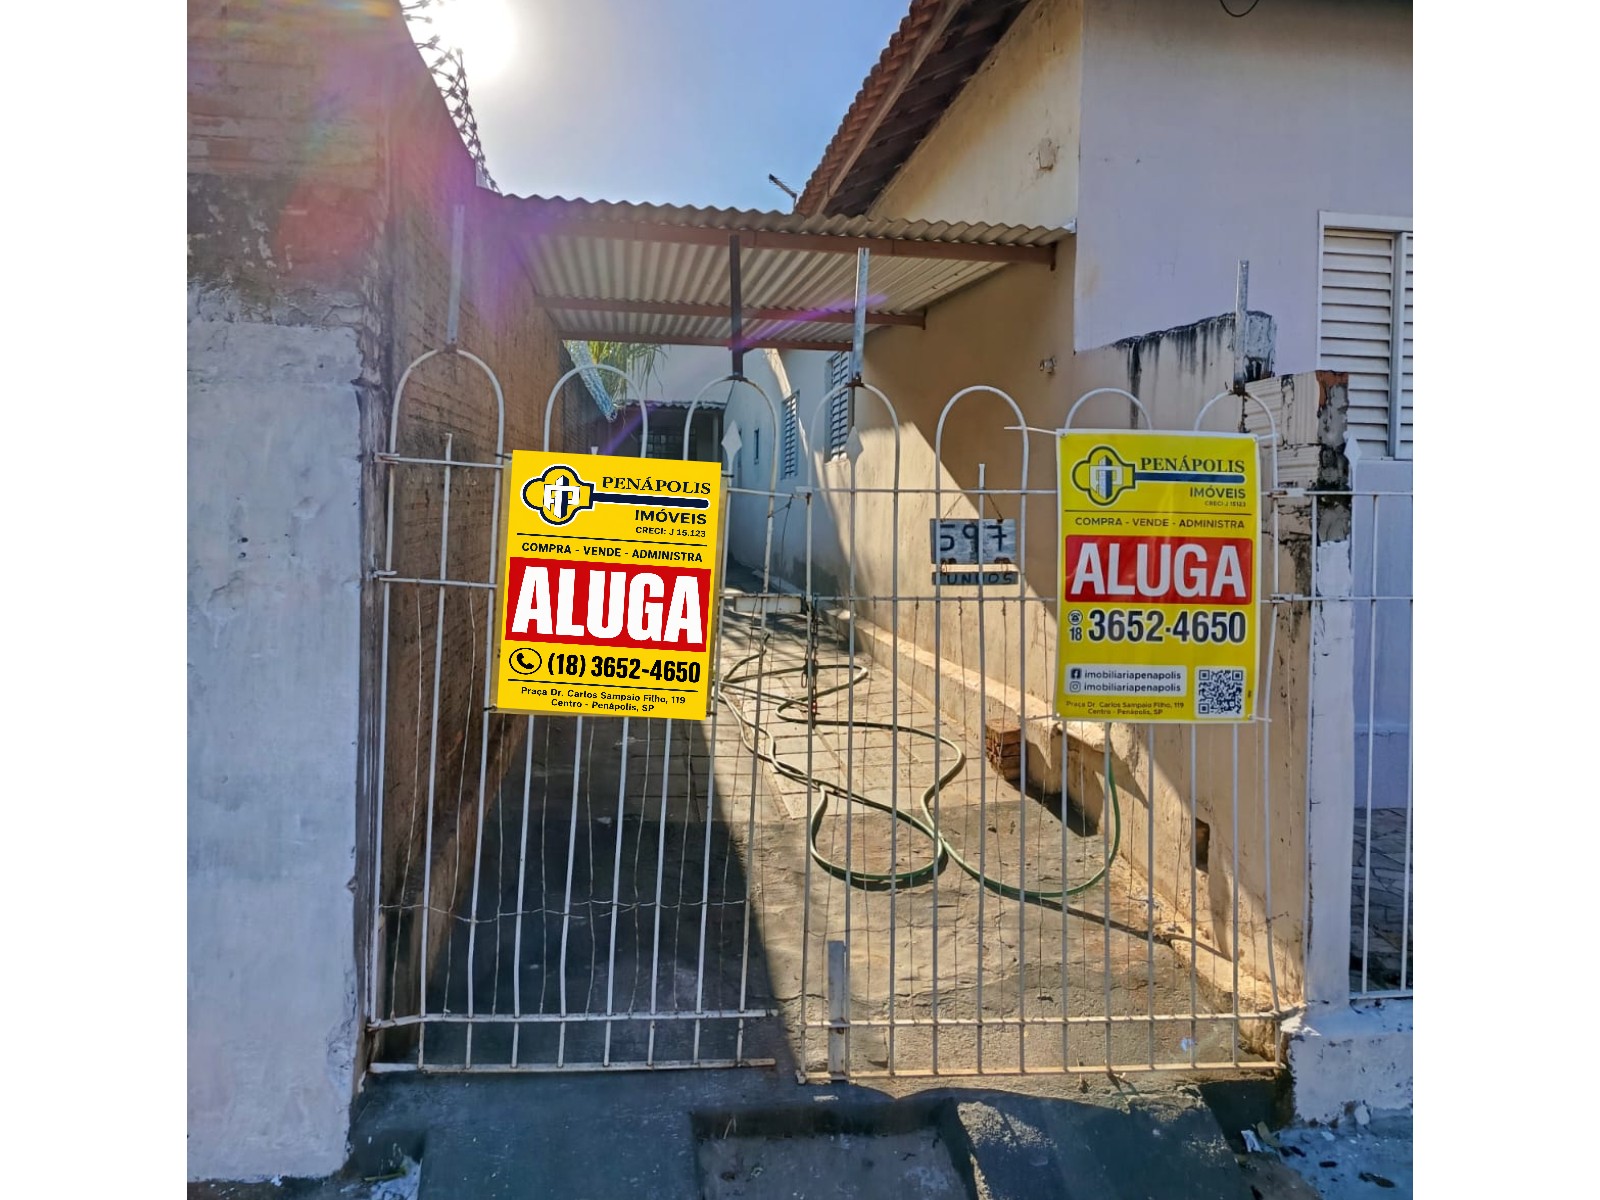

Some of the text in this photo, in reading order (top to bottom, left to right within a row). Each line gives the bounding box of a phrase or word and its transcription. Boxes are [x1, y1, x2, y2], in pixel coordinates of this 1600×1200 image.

[1140, 455, 1245, 473] PENÁPOLIS
[602, 476, 711, 495] PENÁPOLIS
[1190, 485, 1246, 499] IMÓVEIS
[634, 509, 707, 525] IMÓVEIS
[1075, 517, 1122, 526] COMPRA
[1132, 518, 1169, 527] VENDE
[1178, 519, 1245, 529] ADMINISTRA
[635, 526, 706, 538] CRECI: J 15.123
[938, 523, 1008, 552] 597
[521, 542, 572, 554] COMPRA
[583, 546, 622, 557] VENDE
[632, 549, 703, 563] ADMINISTRA
[1070, 542, 1246, 598] ALUGA
[511, 565, 703, 645] ALUGA
[1069, 627, 1083, 641] 18
[547, 652, 701, 683] (18) 3652-4650
[1084, 670, 1181, 681] imobiliariapenapolis
[521, 686, 686, 705] Praça Dr. Carlos Sampaio Filho, 119
[1084, 682, 1181, 693] imobiliariapenapolis
[551, 698, 582, 709] Centro
[592, 701, 639, 713] Penápolis,
[642, 704, 655, 712] SP
